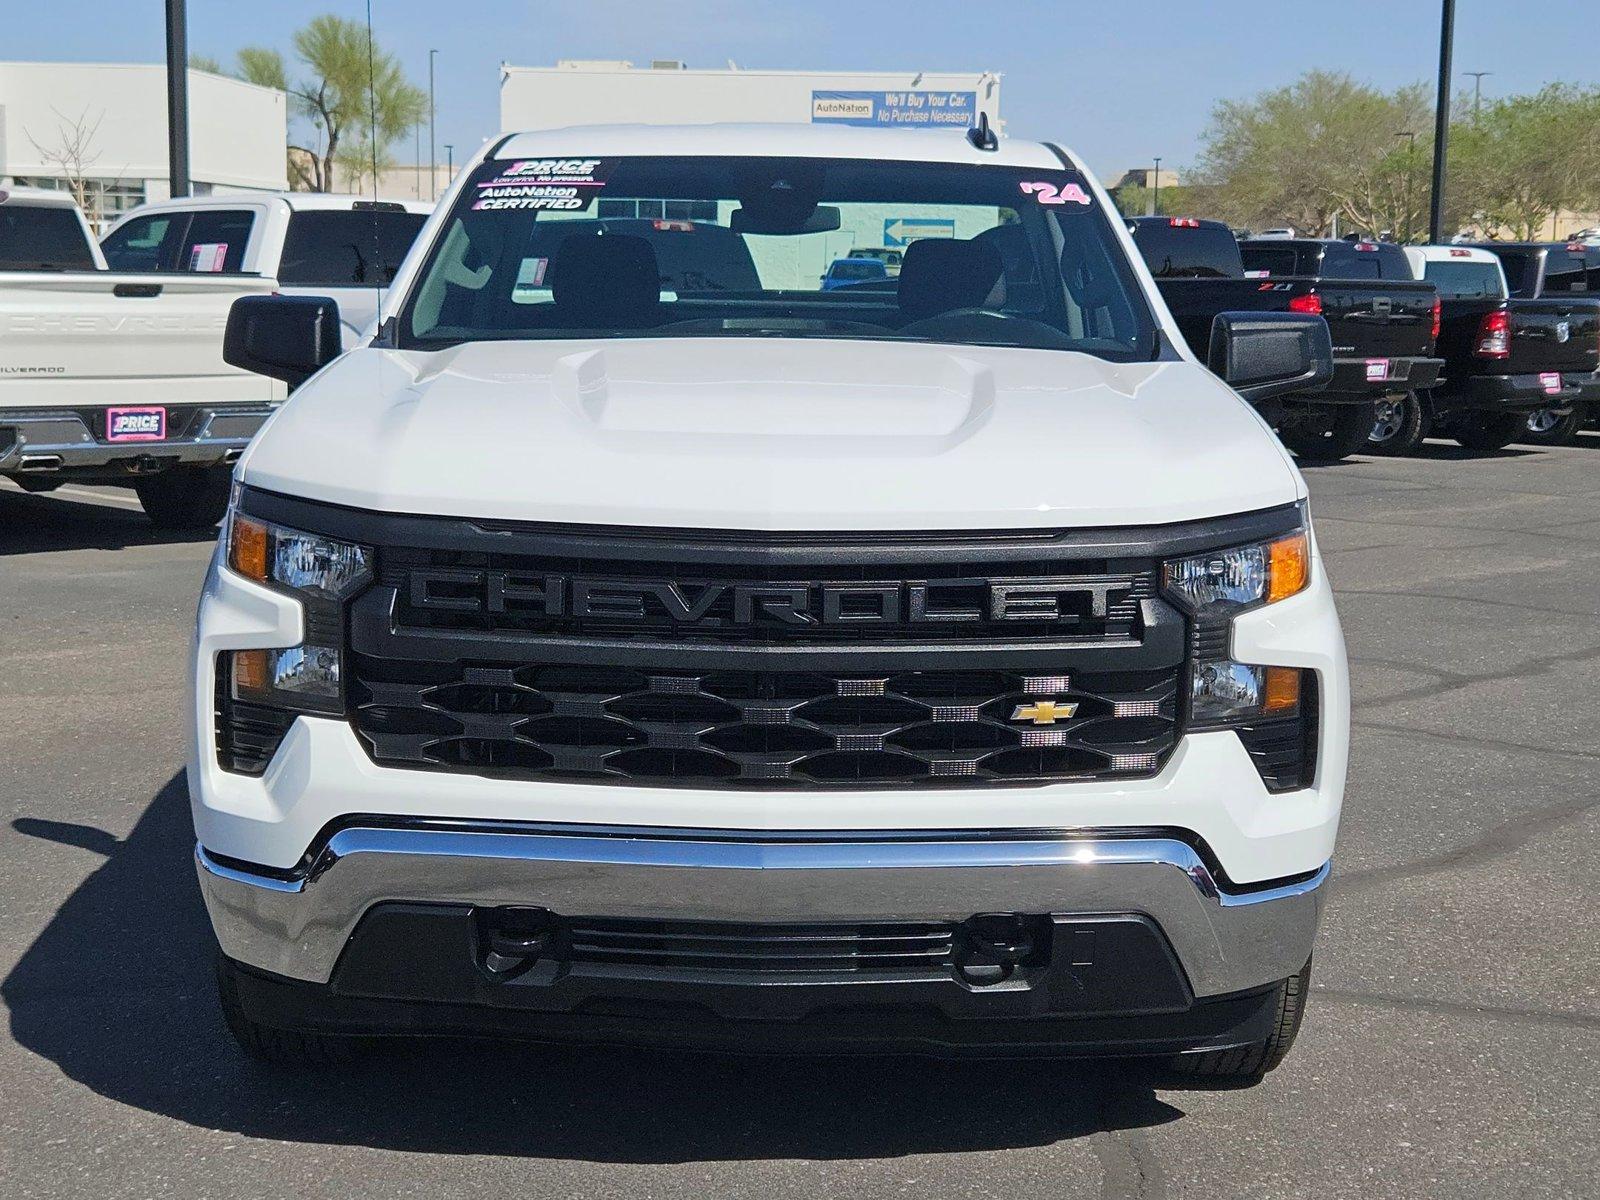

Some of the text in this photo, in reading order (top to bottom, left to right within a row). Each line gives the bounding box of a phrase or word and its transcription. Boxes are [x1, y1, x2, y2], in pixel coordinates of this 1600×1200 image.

[885, 92, 967, 108] We'll Buy Your Car.
[815, 102, 870, 113] AutoNation
[877, 109, 974, 126] No Purchase Necessary.
[479, 187, 578, 198] AutoNation
[480, 198, 583, 211] CERTIFIED
[408, 571, 1134, 625] CHEVROLET
